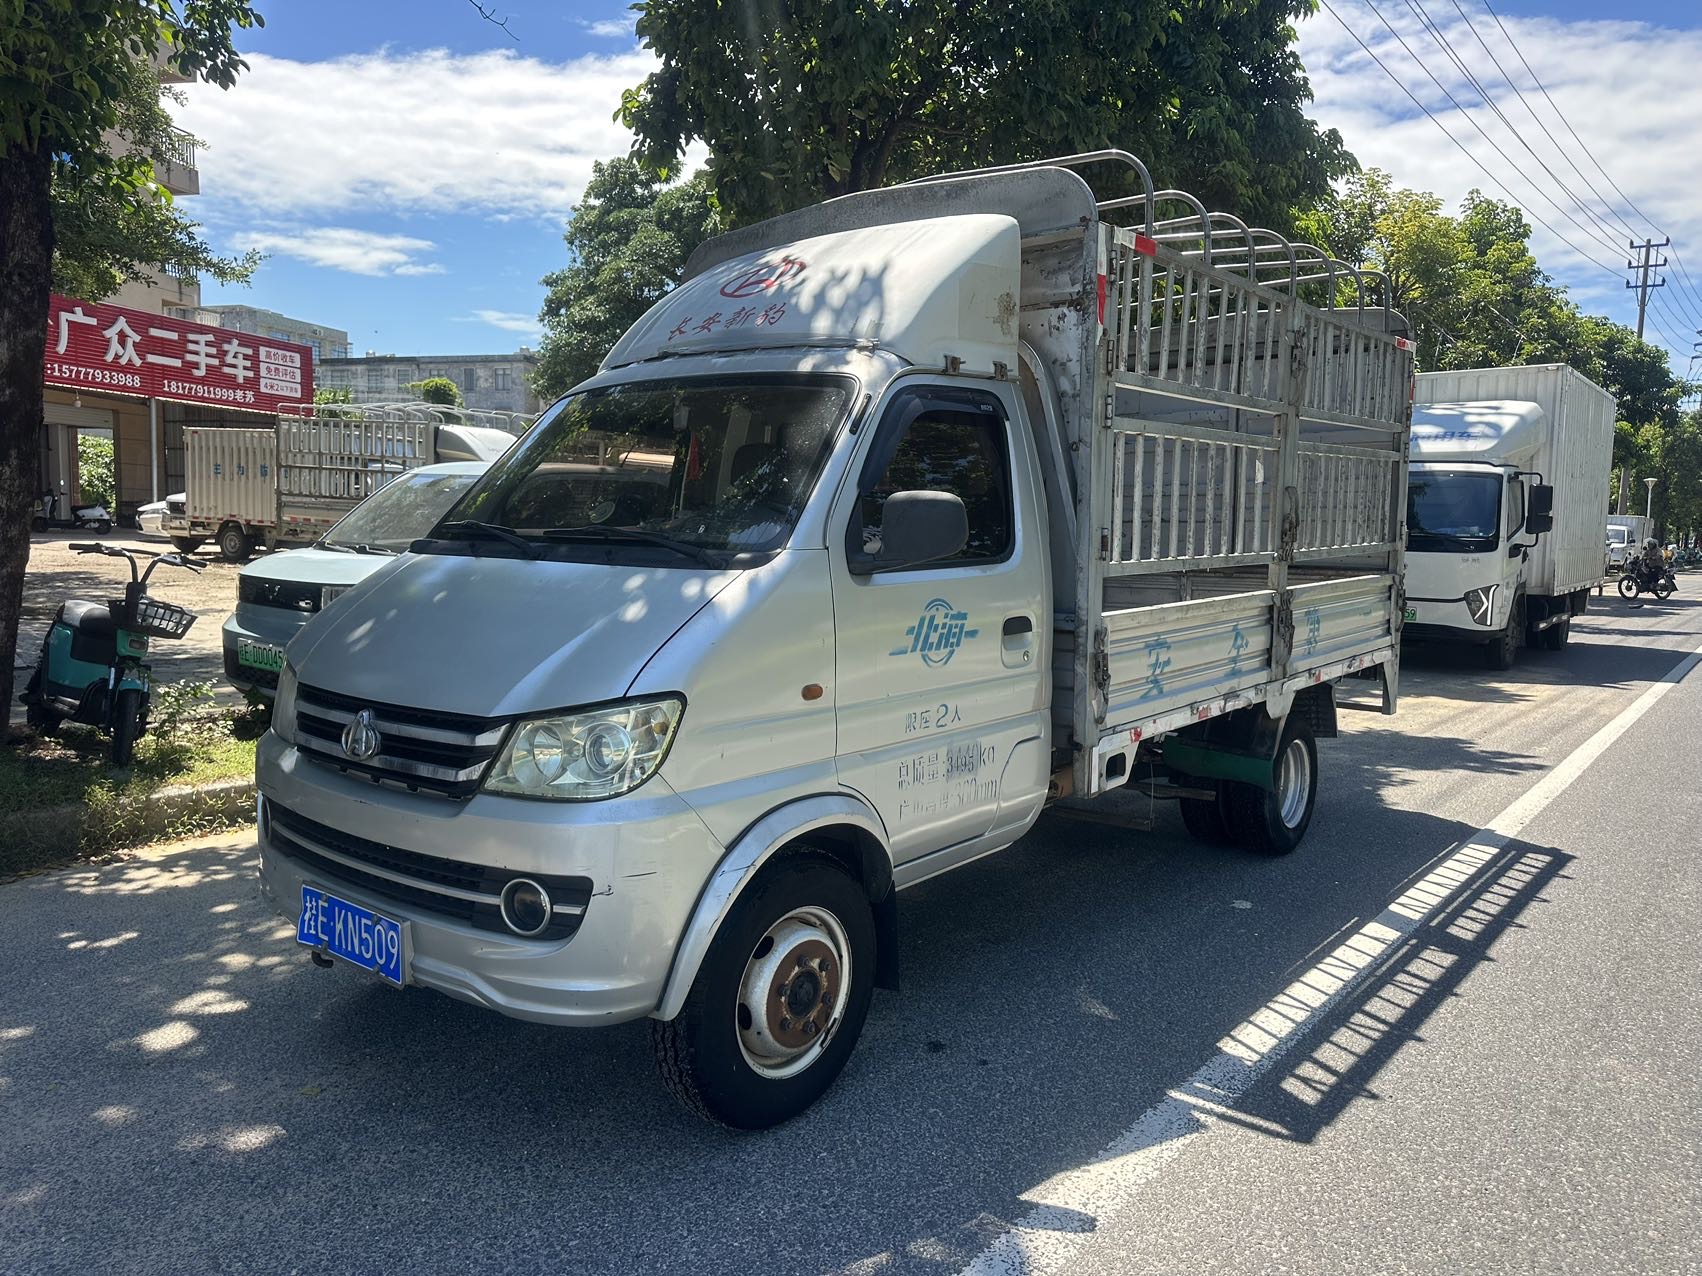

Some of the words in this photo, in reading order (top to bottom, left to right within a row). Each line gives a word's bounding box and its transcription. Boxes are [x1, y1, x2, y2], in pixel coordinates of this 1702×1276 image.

[668, 303, 786, 341] 长安新豹
[56, 307, 254, 384] 广众二手车
[265, 350, 296, 364] 高价收车
[265, 365, 296, 380] 免费评估
[888, 611, 981, 656] 北海
[904, 703, 962, 733] 限座2人
